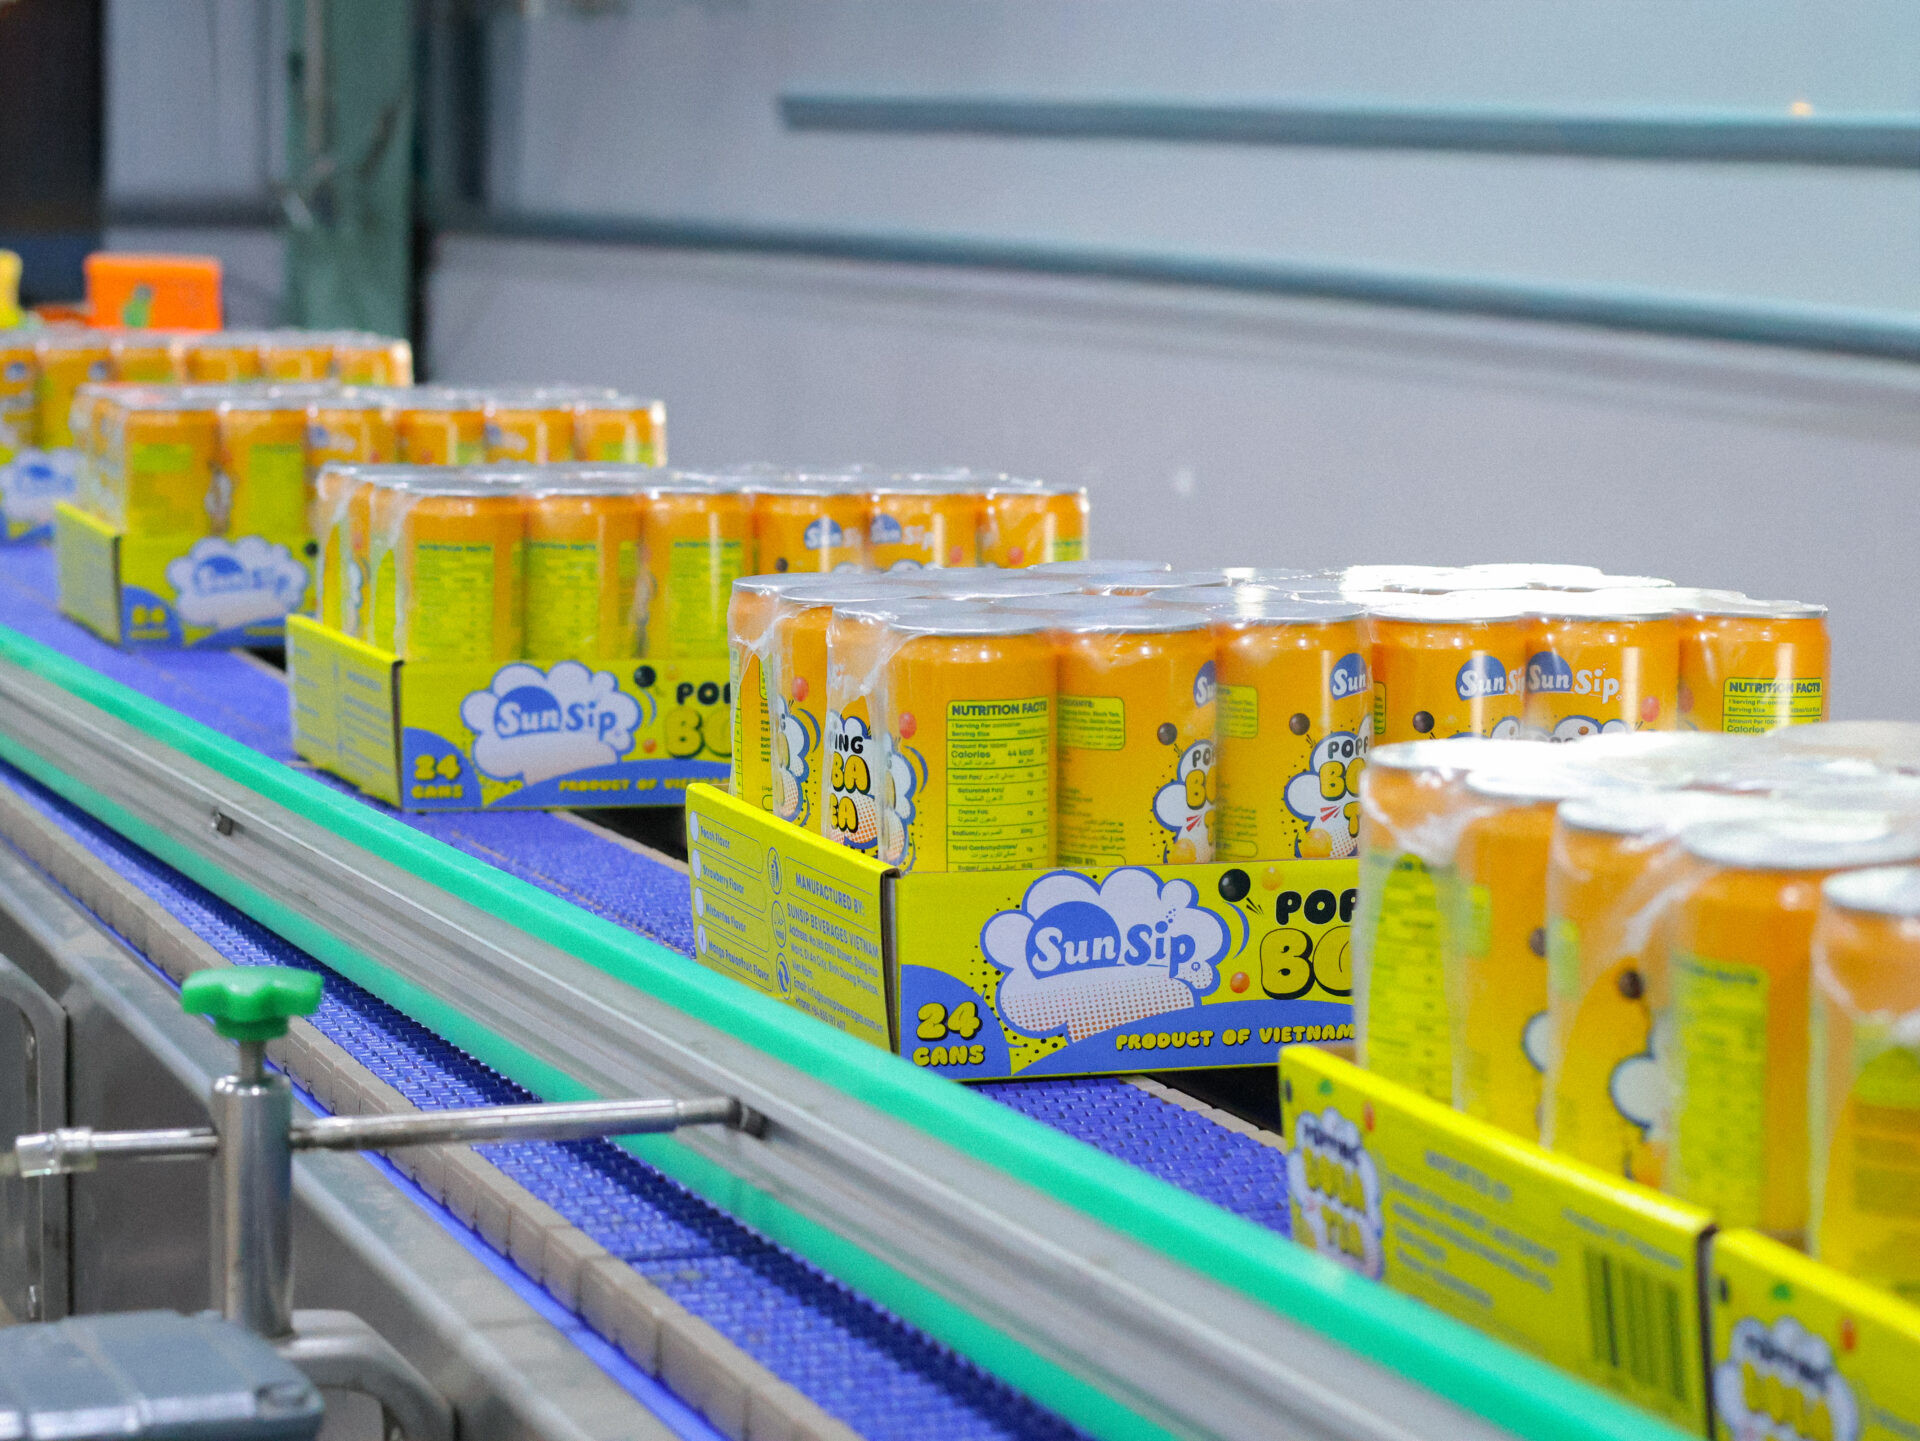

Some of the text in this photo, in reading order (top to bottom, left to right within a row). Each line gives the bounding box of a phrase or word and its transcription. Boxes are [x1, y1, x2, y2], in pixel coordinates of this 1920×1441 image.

[1729, 682, 1820, 693] NUTRITION FACTS
[952, 704, 1019, 716] NUTRITION
[1021, 700, 1047, 714] FACTS
[1727, 725, 1765, 733] Calories
[951, 750, 991, 759] Calories
[414, 754, 462, 781] 24
[796, 872, 852, 911] MANUFACTURED
[787, 902, 809, 926] SUNSIP
[810, 914, 848, 944] BEVERAGES
[849, 931, 879, 958] VIETNAM
[916, 1001, 983, 1041] 24
[1115, 1023, 1356, 1052] PRODUCT OF VIETNAM
[912, 1044, 986, 1067] CANS
